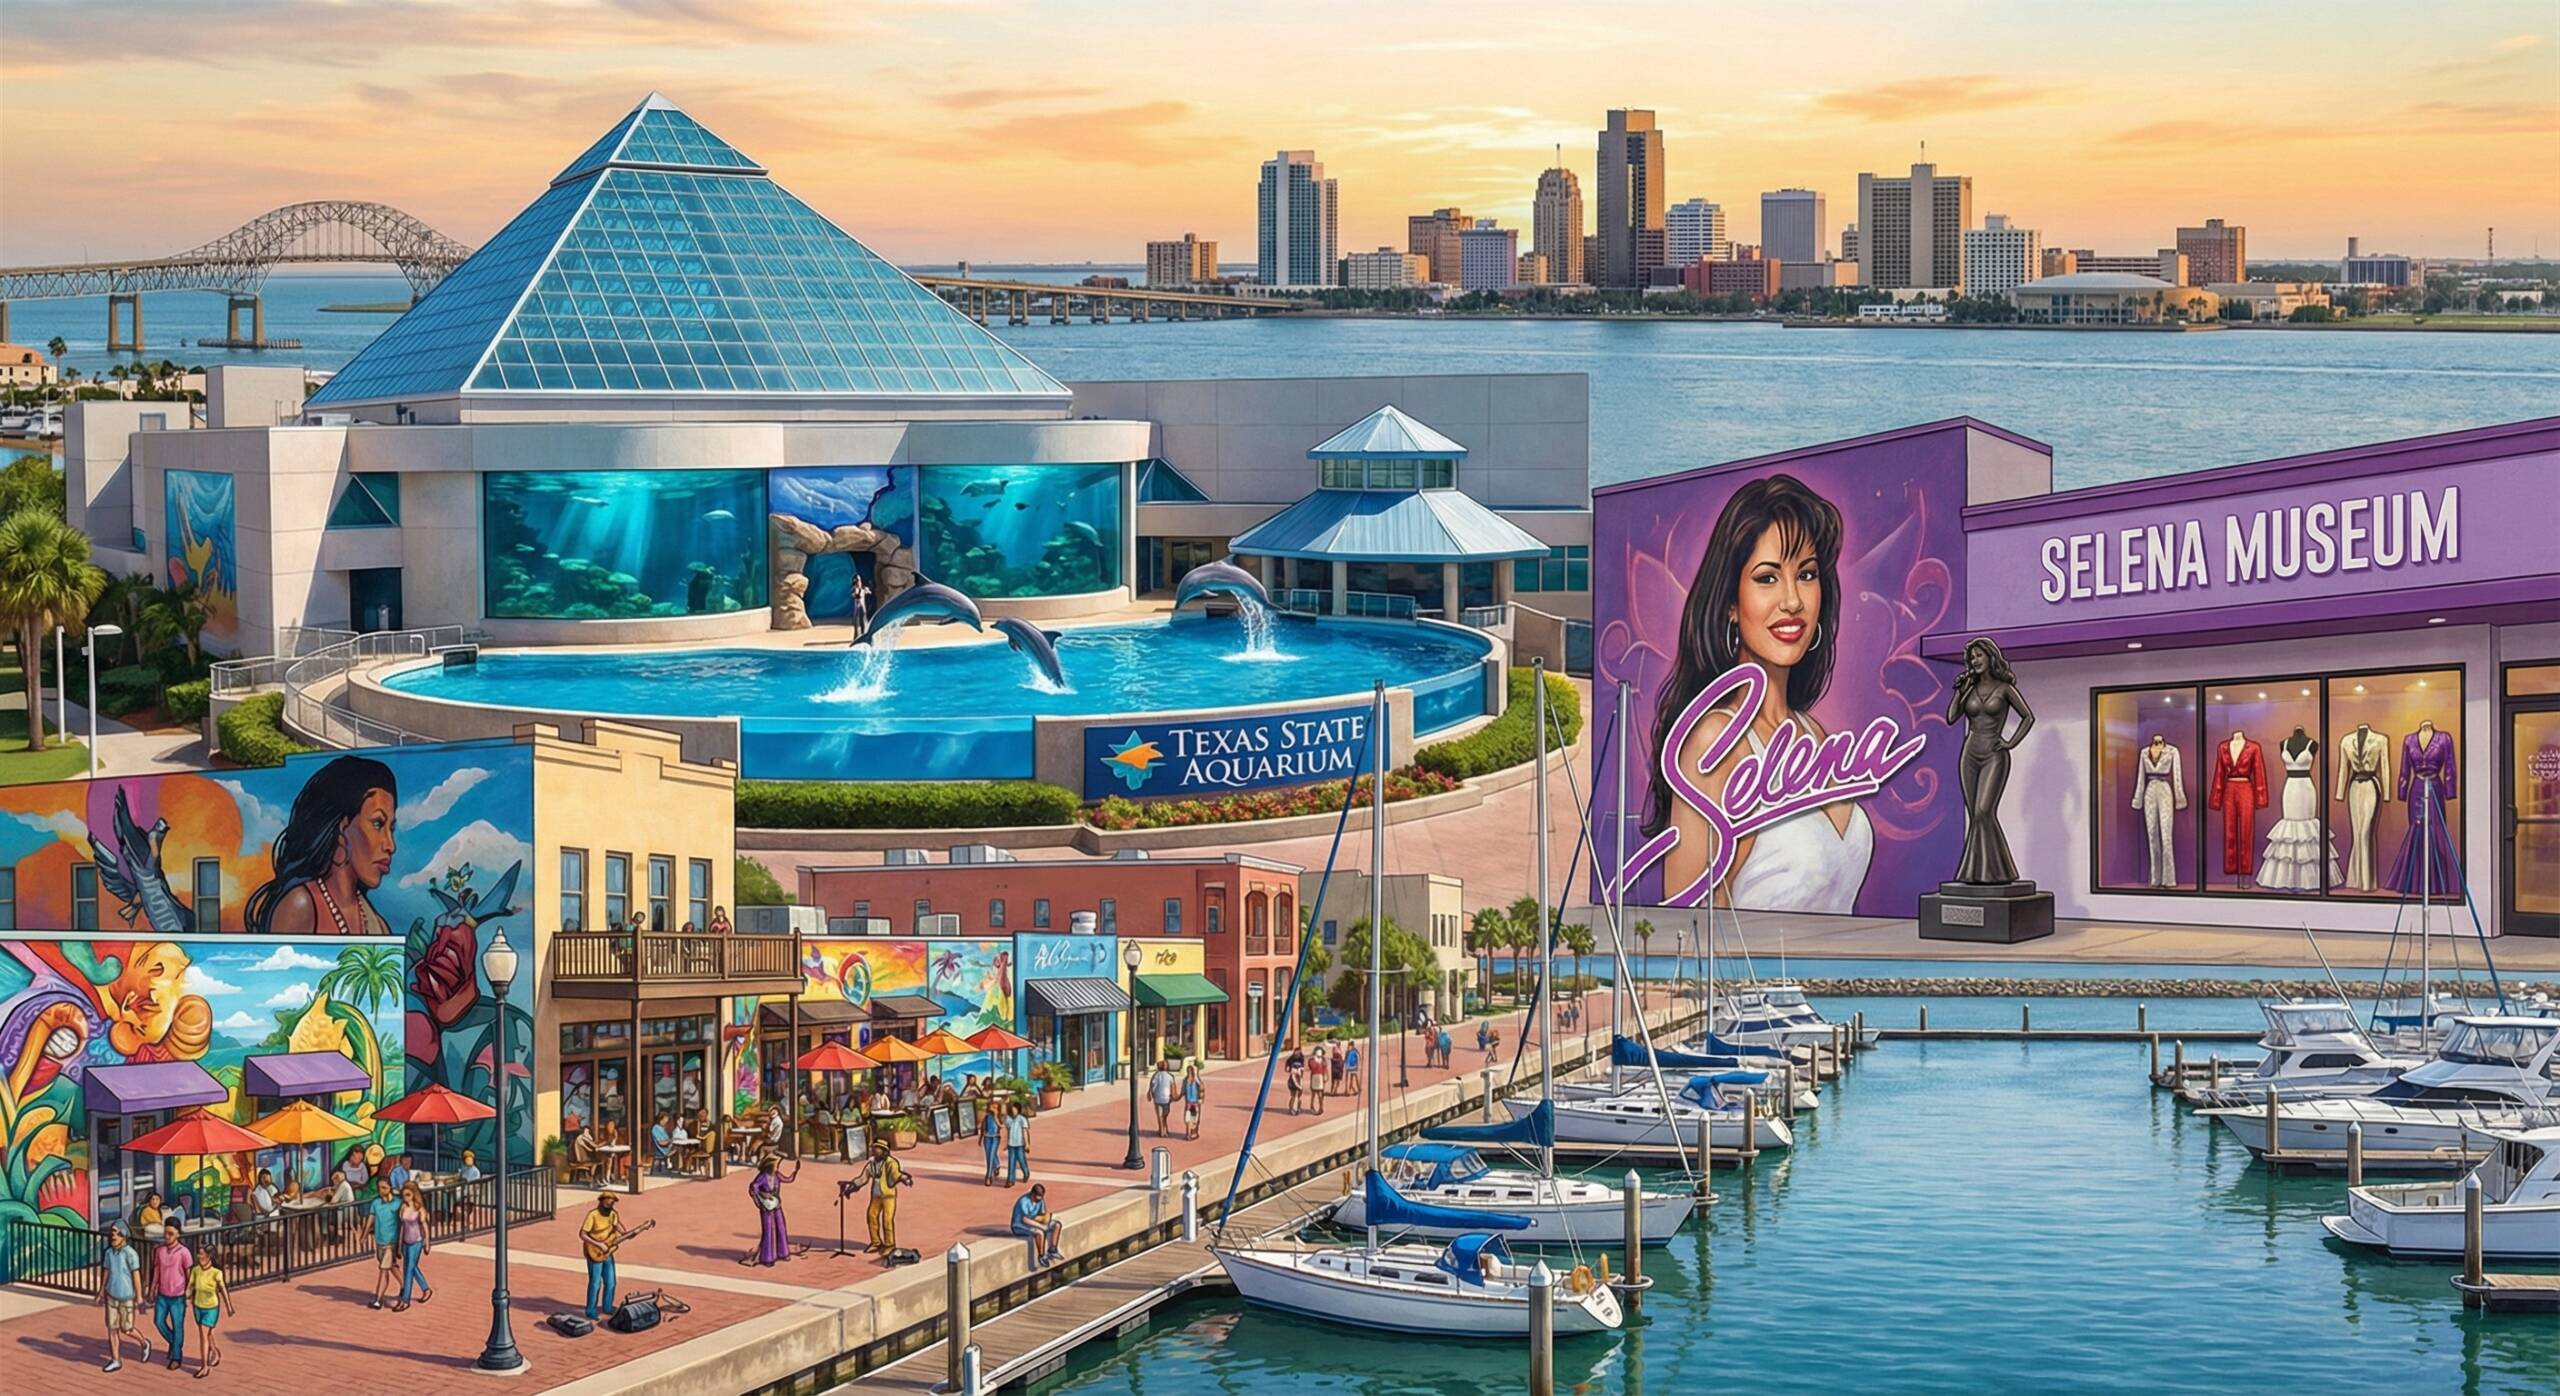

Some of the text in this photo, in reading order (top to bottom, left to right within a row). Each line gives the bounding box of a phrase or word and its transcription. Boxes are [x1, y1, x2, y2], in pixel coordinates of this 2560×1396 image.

[2041, 487, 2459, 603] SELENA MUSEUM
[1169, 715, 1365, 758] TEXAS STATE
[1179, 746, 1355, 787] AQUARIUM
[1607, 663, 1926, 906] Selena
